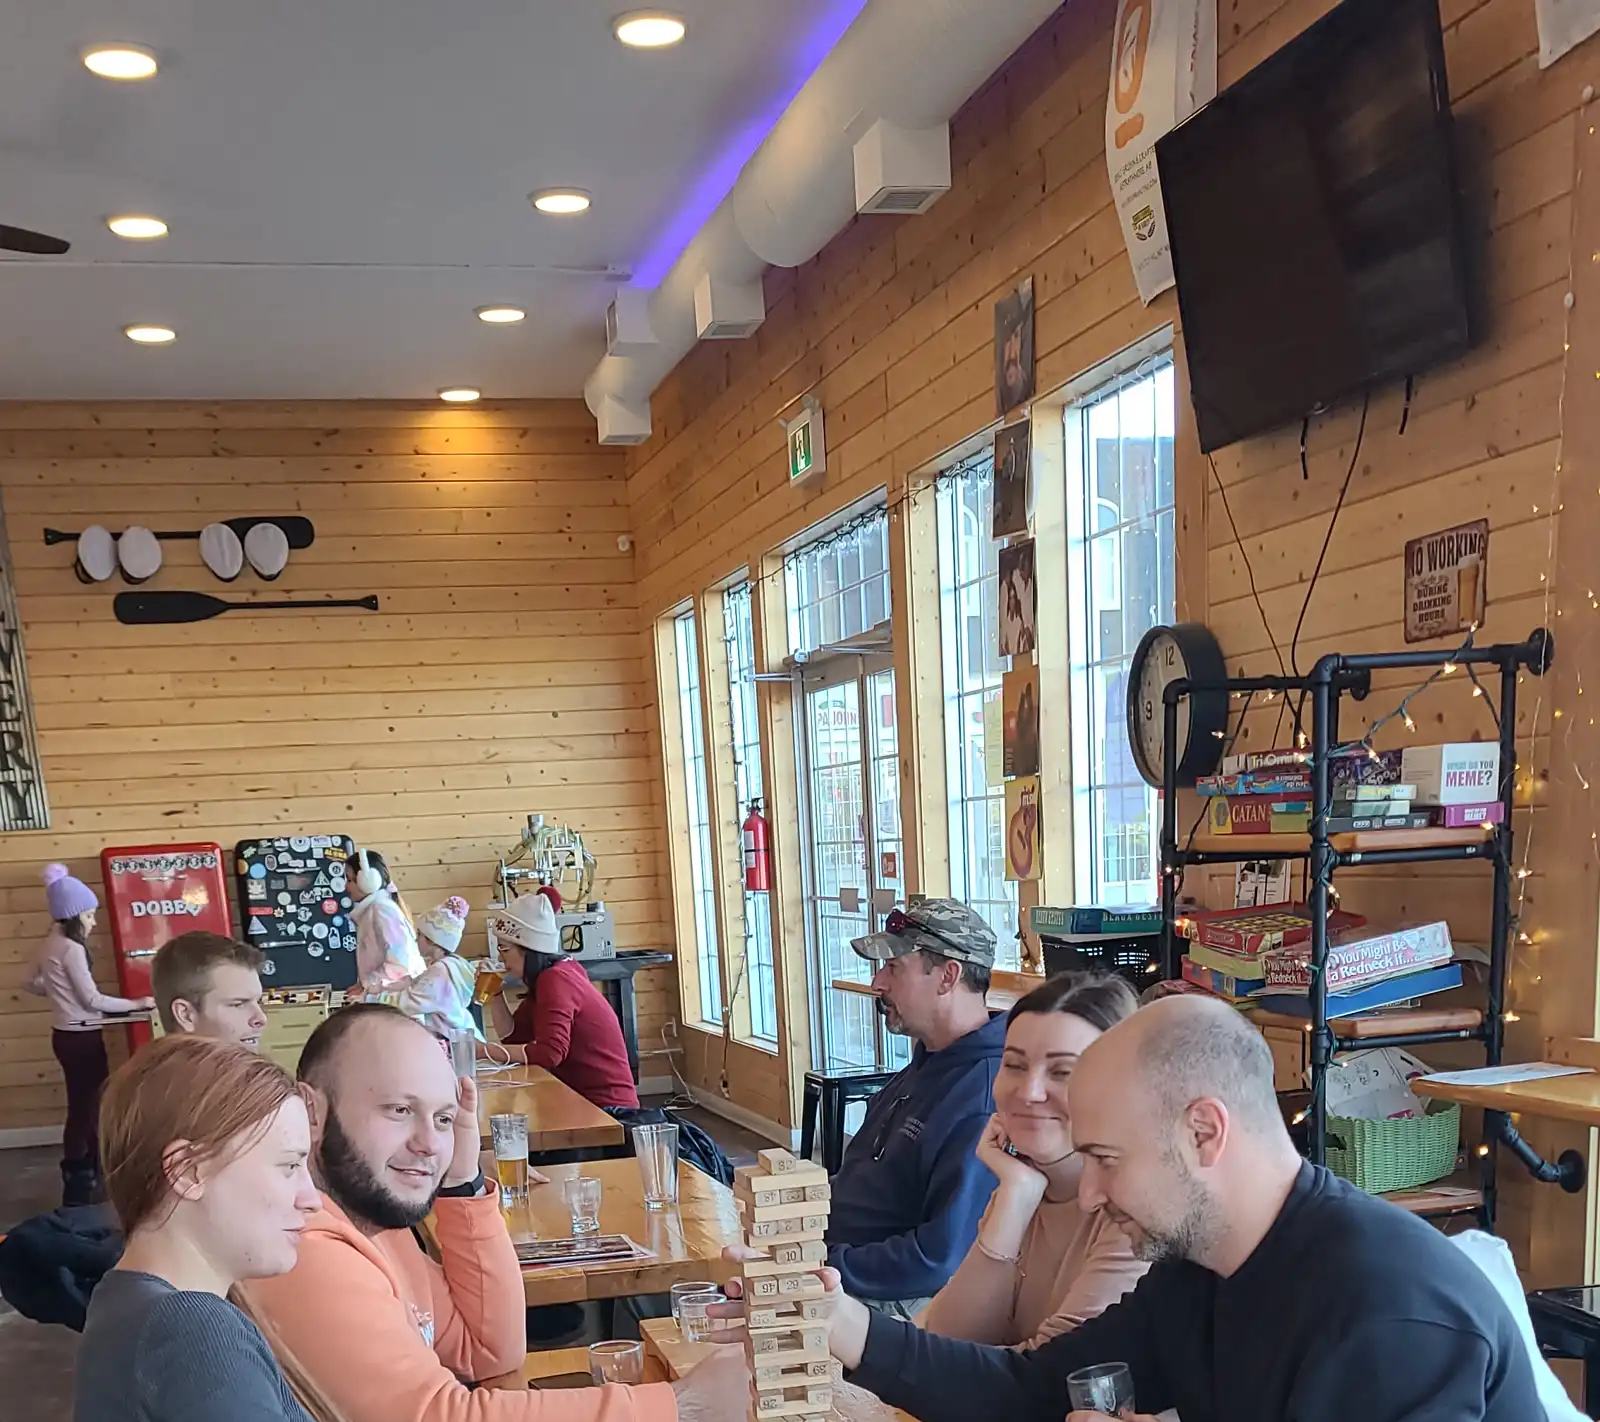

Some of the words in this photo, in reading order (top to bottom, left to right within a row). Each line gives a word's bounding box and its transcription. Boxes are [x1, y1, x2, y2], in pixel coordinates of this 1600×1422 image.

[1409, 546, 1424, 577] NO
[1427, 531, 1485, 573] WORKING
[1417, 583, 1448, 599] DURING
[1413, 595, 1452, 612] DRINKING
[1418, 608, 1445, 623] HOURS
[1165, 645, 1175, 666] 12
[1146, 700, 1153, 721] 9
[1480, 760, 1494, 769] YOU
[1446, 770, 1493, 787] MEME?
[1232, 804, 1267, 823] CATAN
[1338, 951, 1360, 965] You
[1360, 943, 1390, 960] Might
[1393, 939, 1407, 950] Be
[1331, 970, 1339, 981] a
[1340, 957, 1394, 978] Redneck
[778, 1160, 793, 1171] 32
[757, 1224, 770, 1235] 17
[785, 1250, 797, 1262] 10
[786, 1280, 799, 1290] 29
